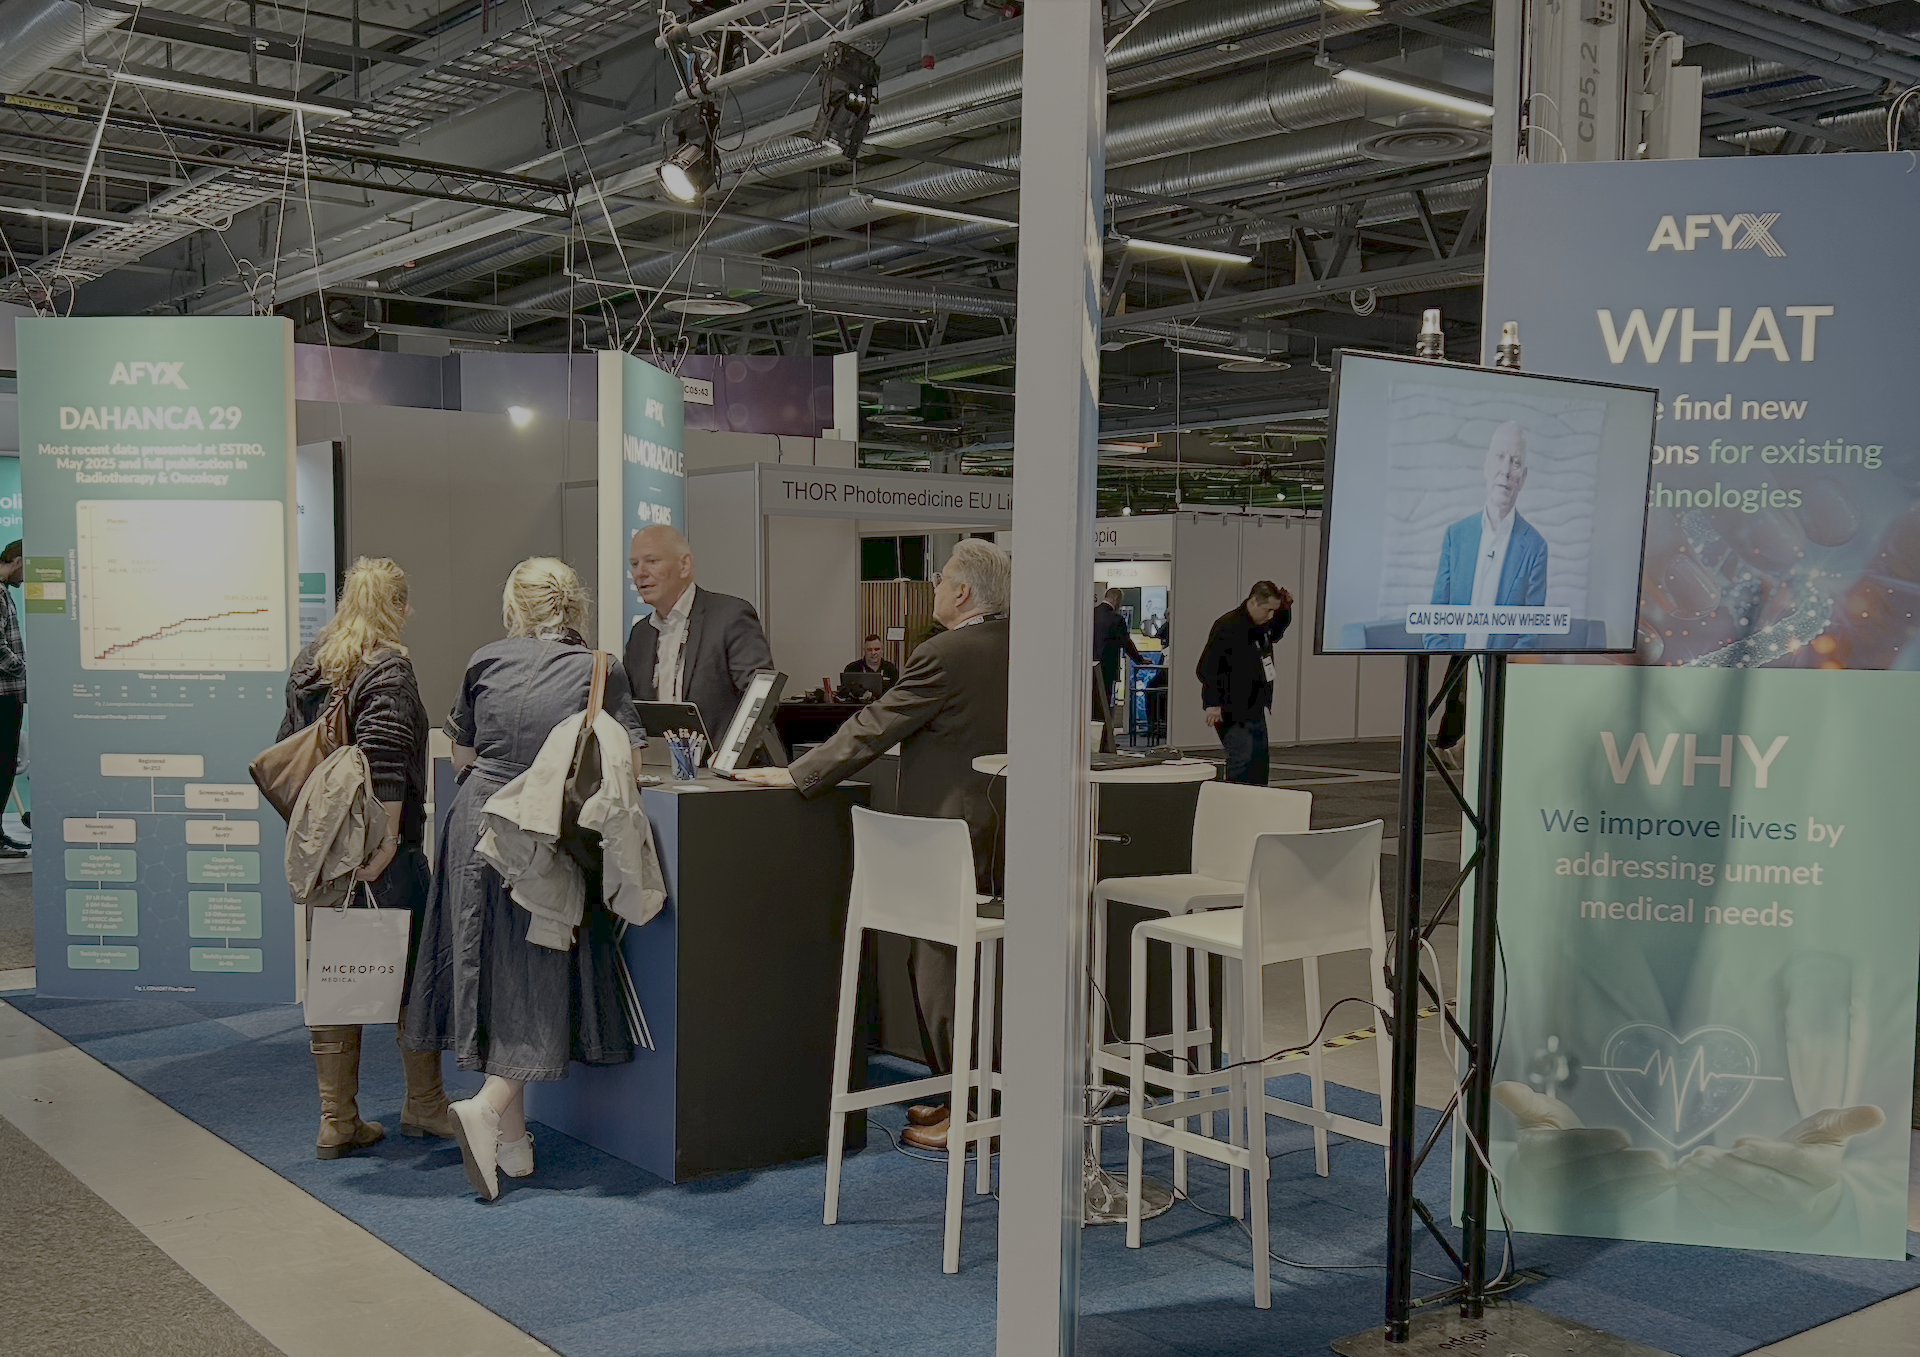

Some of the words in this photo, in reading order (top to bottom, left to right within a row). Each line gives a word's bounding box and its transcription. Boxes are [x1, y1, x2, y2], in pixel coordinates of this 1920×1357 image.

[1578, 41, 1600, 143] CP5,2
[1647, 212, 1787, 258] AFYX
[1597, 305, 1834, 364] WHAT
[109, 361, 190, 390] AFYX
[59, 406, 205, 430] DAHANCA
[208, 405, 242, 430] 29
[1673, 394, 1732, 421] find
[1741, 399, 1808, 421] new
[38, 443, 70, 456] Most
[71, 443, 110, 456] recent
[112, 443, 140, 456] data
[141, 443, 202, 458] presented
[203, 444, 217, 455] at
[219, 443, 266, 457] ESTRO,
[56, 458, 83, 472] May
[85, 458, 116, 470] 2025
[118, 458, 142, 470] and
[143, 457, 164, 470] full
[165, 457, 234, 472] publication
[235, 458, 248, 470] in
[624, 433, 684, 478] NIMORAZOLE
[1708, 438, 1752, 465] for
[1761, 438, 1883, 470] existing
[75, 472, 156, 486] Radiotherapy
[157, 473, 168, 484] &
[169, 472, 229, 486] Oncology
[782, 480, 837, 502] THOR
[844, 484, 963, 509] Photomedicine
[969, 491, 992, 510] EU
[650, 502, 672, 526] YEARS
[1409, 612, 1431, 625] CAN
[1433, 612, 1465, 625] SHOW
[1467, 612, 1489, 626] DATA
[1491, 613, 1517, 626] NOW
[1518, 613, 1551, 626] WHERE
[1552, 613, 1568, 627] WE
[1600, 731, 1790, 789] WHY
[1539, 808, 1590, 834] We
[1599, 810, 1721, 841] improve
[1730, 814, 1798, 841] lives
[1807, 816, 1846, 849] by
[1555, 851, 1716, 887] addressing
[1725, 862, 1824, 886] unmet
[1580, 897, 1694, 924] medical
[1704, 901, 1794, 928] needs
[321, 964, 395, 974] MICROPOS
